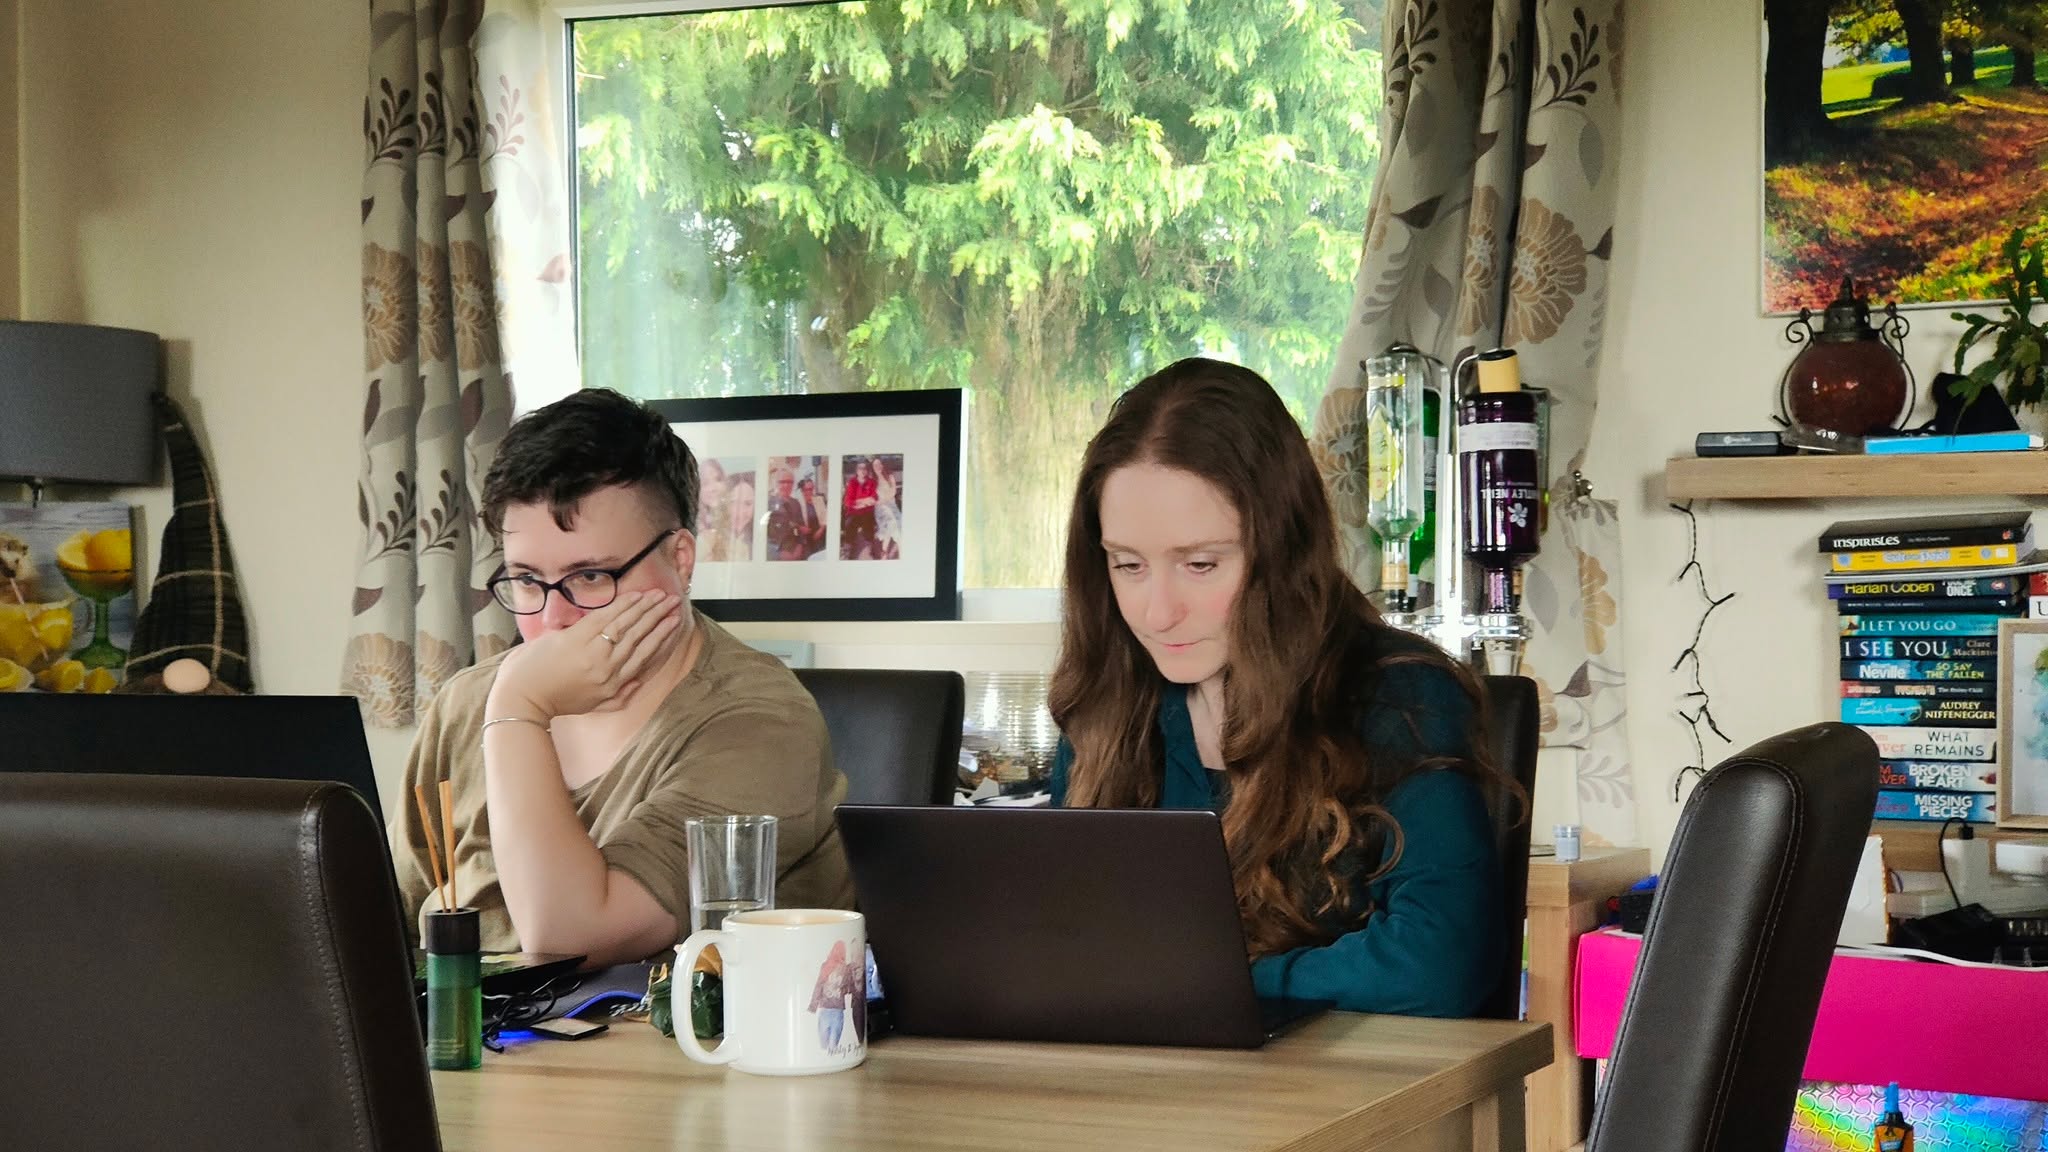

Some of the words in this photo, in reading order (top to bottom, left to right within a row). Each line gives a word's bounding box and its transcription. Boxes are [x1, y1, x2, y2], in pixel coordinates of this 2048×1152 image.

[1845, 583, 1888, 595] Harlan
[1891, 582, 1935, 594] Coben
[1946, 585, 1974, 597] ONCE
[1861, 620, 1866, 631] I
[1870, 620, 1894, 631] LET
[1899, 620, 1931, 631] YOU
[1933, 620, 1956, 631] GO
[1845, 641, 1851, 657] I
[1860, 641, 1894, 657] SEE
[1901, 641, 1947, 657] YOU
[1966, 640, 1991, 648] Clare
[1859, 664, 1907, 679] Neville
[1936, 663, 1950, 671] SO
[1954, 663, 1973, 671] SAY
[1925, 671, 1945, 679] THE
[1948, 671, 1984, 679] FALLEN
[1939, 701, 1981, 711] AUDREY
[1925, 710, 1996, 720] NIFFENEGGER
[1927, 731, 1970, 742] WHAT
[1914, 744, 1985, 756] REMAINS
[1909, 764, 1972, 777] BROKEN
[1915, 776, 1965, 788] HEART
[1914, 795, 1973, 808] MISSING
[1919, 806, 1968, 818] PIECES
